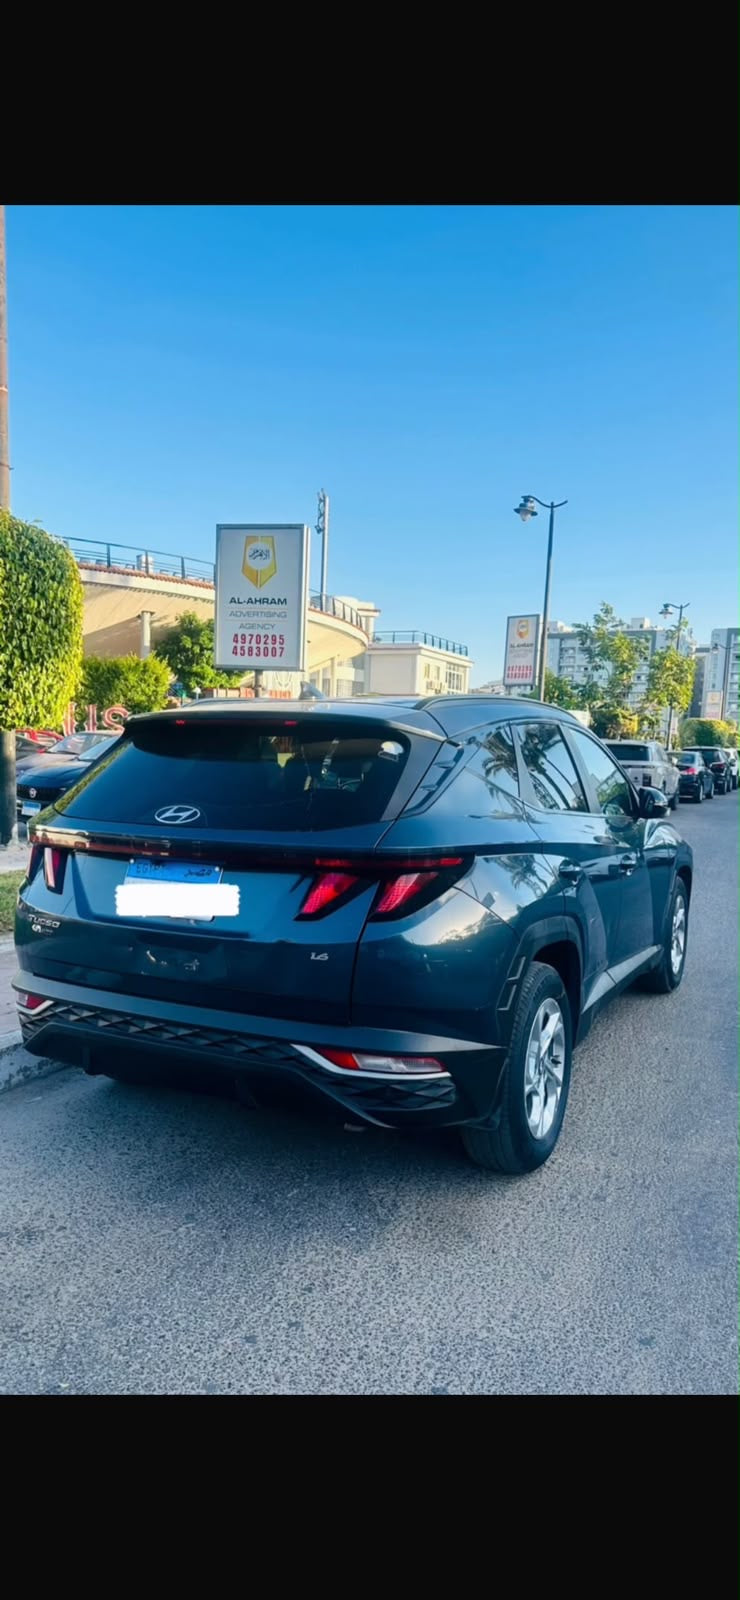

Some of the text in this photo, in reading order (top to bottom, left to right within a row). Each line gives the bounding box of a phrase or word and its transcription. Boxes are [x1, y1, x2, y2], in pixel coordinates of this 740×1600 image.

[229, 596, 288, 606] AL-AHRAM
[229, 610, 288, 619] ADVERTISING
[239, 622, 276, 631] AGENCY
[232, 633, 285, 646] 4970295
[232, 645, 285, 658] 4583007
